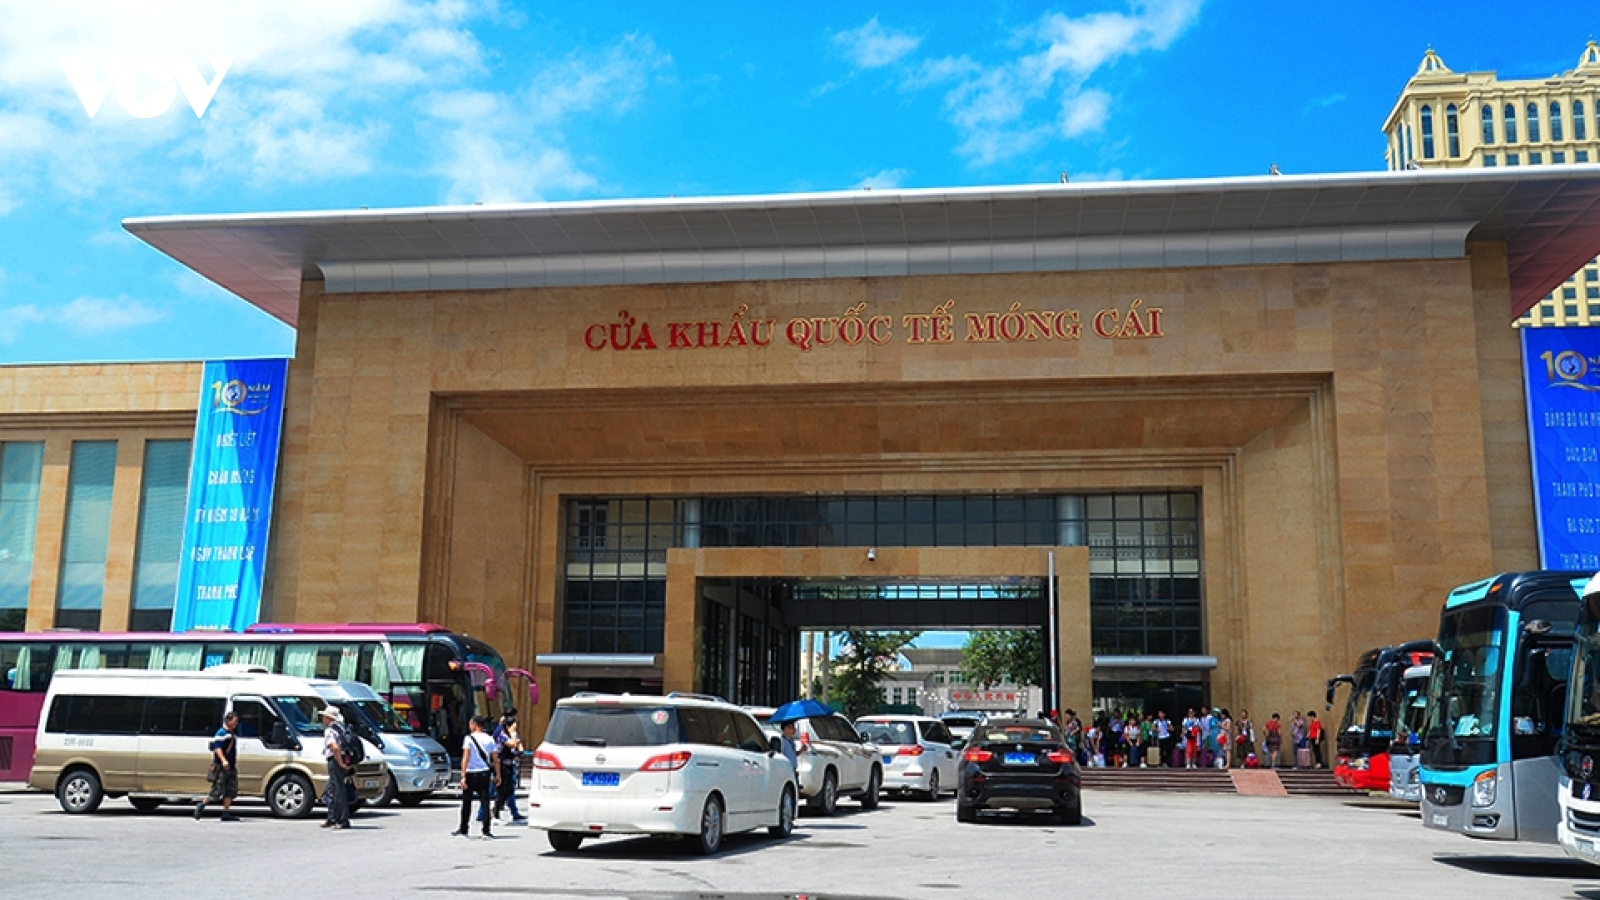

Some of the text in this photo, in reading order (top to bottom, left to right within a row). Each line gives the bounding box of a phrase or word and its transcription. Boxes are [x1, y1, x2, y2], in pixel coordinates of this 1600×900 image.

[583, 298, 1165, 352] CỬA KHẨU QUỐC TẾ MÓNG CÁI
[1540, 350, 1587, 381] 10
[211, 379, 247, 408] 10
